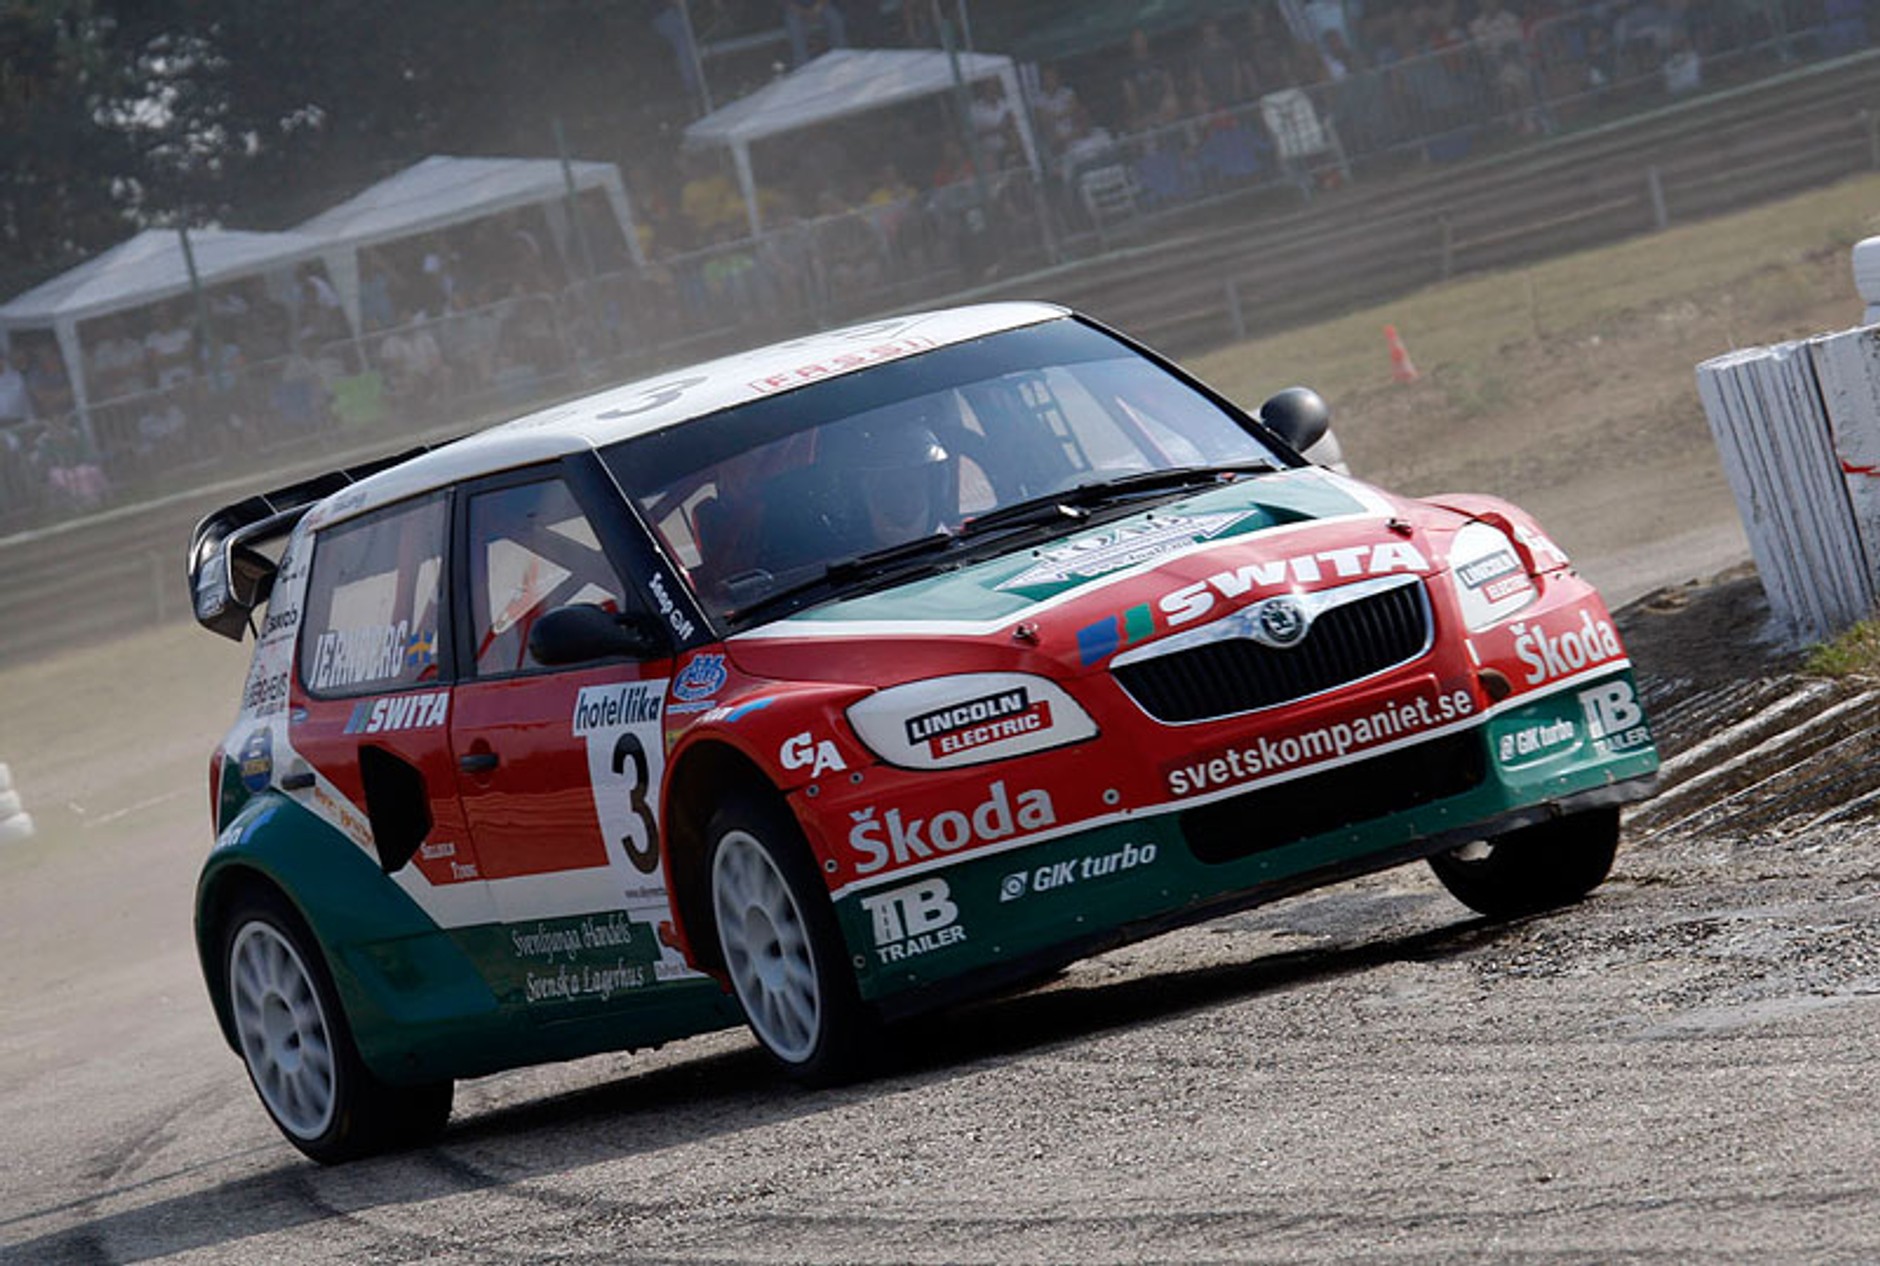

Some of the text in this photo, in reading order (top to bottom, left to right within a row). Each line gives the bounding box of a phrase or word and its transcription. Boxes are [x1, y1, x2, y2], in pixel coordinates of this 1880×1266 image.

[1158, 541, 1430, 627] SWITA
[1508, 609, 1622, 685] Škoda
[366, 693, 449, 734] SWITA
[911, 693, 1022, 739] LINCOLN
[941, 713, 1041, 753] ELECTRIC
[1168, 690, 1473, 795] svetskompaniet.se
[780, 731, 848, 778] GA
[611, 731, 660, 875] 3
[849, 780, 1057, 873] Škoda
[1032, 843, 1157, 892] GIK turbo
[861, 878, 959, 946] TB
[876, 925, 967, 964] TRAILER
